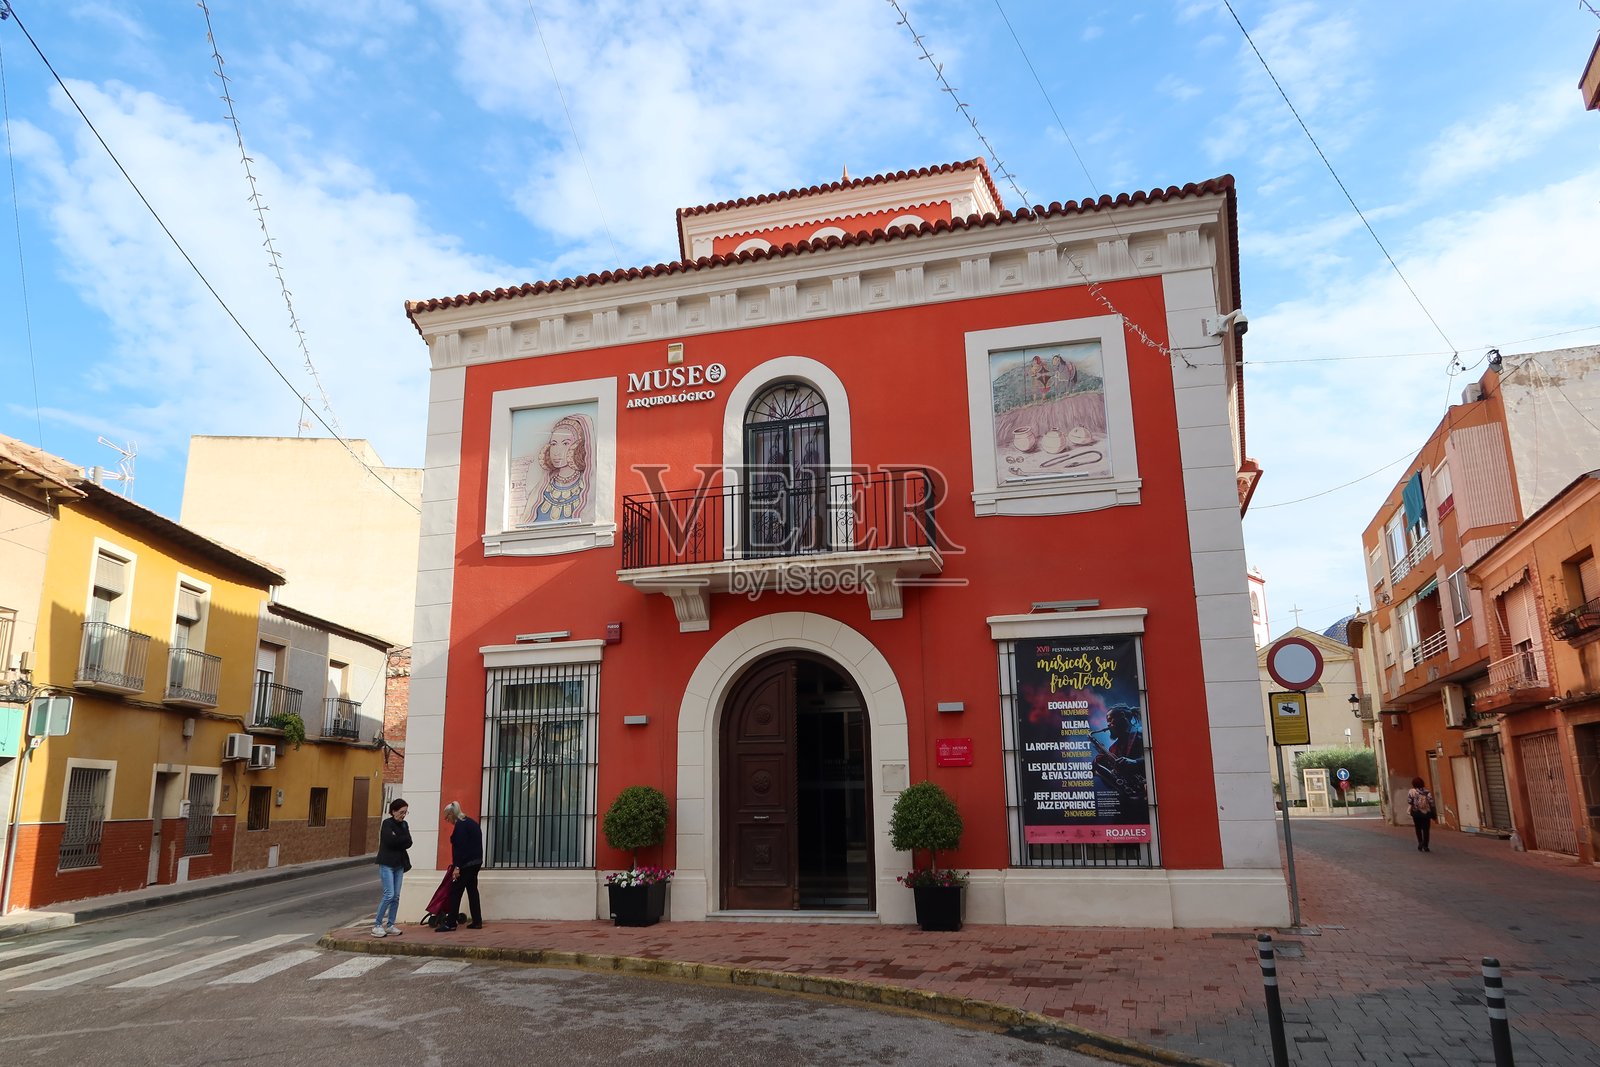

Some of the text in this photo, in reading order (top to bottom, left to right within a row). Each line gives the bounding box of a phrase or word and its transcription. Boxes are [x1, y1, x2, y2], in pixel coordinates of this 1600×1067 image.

[627, 363, 727, 393] MUSEO
[626, 390, 716, 409] ARQUEOLÓGICO
[1036, 645, 1050, 653] XVII
[1036, 653, 1092, 672] músicas
[1050, 670, 1114, 694] fronteras
[1048, 701, 1088, 710] EOGHANXO
[1062, 720, 1090, 729] KILEMA
[1026, 741, 1091, 750] LA ROFFA PROJECT
[1028, 763, 1041, 771] LES
[1042, 763, 1056, 771] DUC
[1068, 762, 1092, 770] SWING
[1042, 772, 1048, 780] &
[1064, 771, 1093, 779] SLONGO
[1034, 792, 1050, 800] JEFF
[1050, 792, 1095, 800] JEROLAMON
[1037, 802, 1054, 810] JAZZ
[1055, 801, 1096, 809] EXPRIENCE
[1106, 828, 1146, 837] ROJALES
